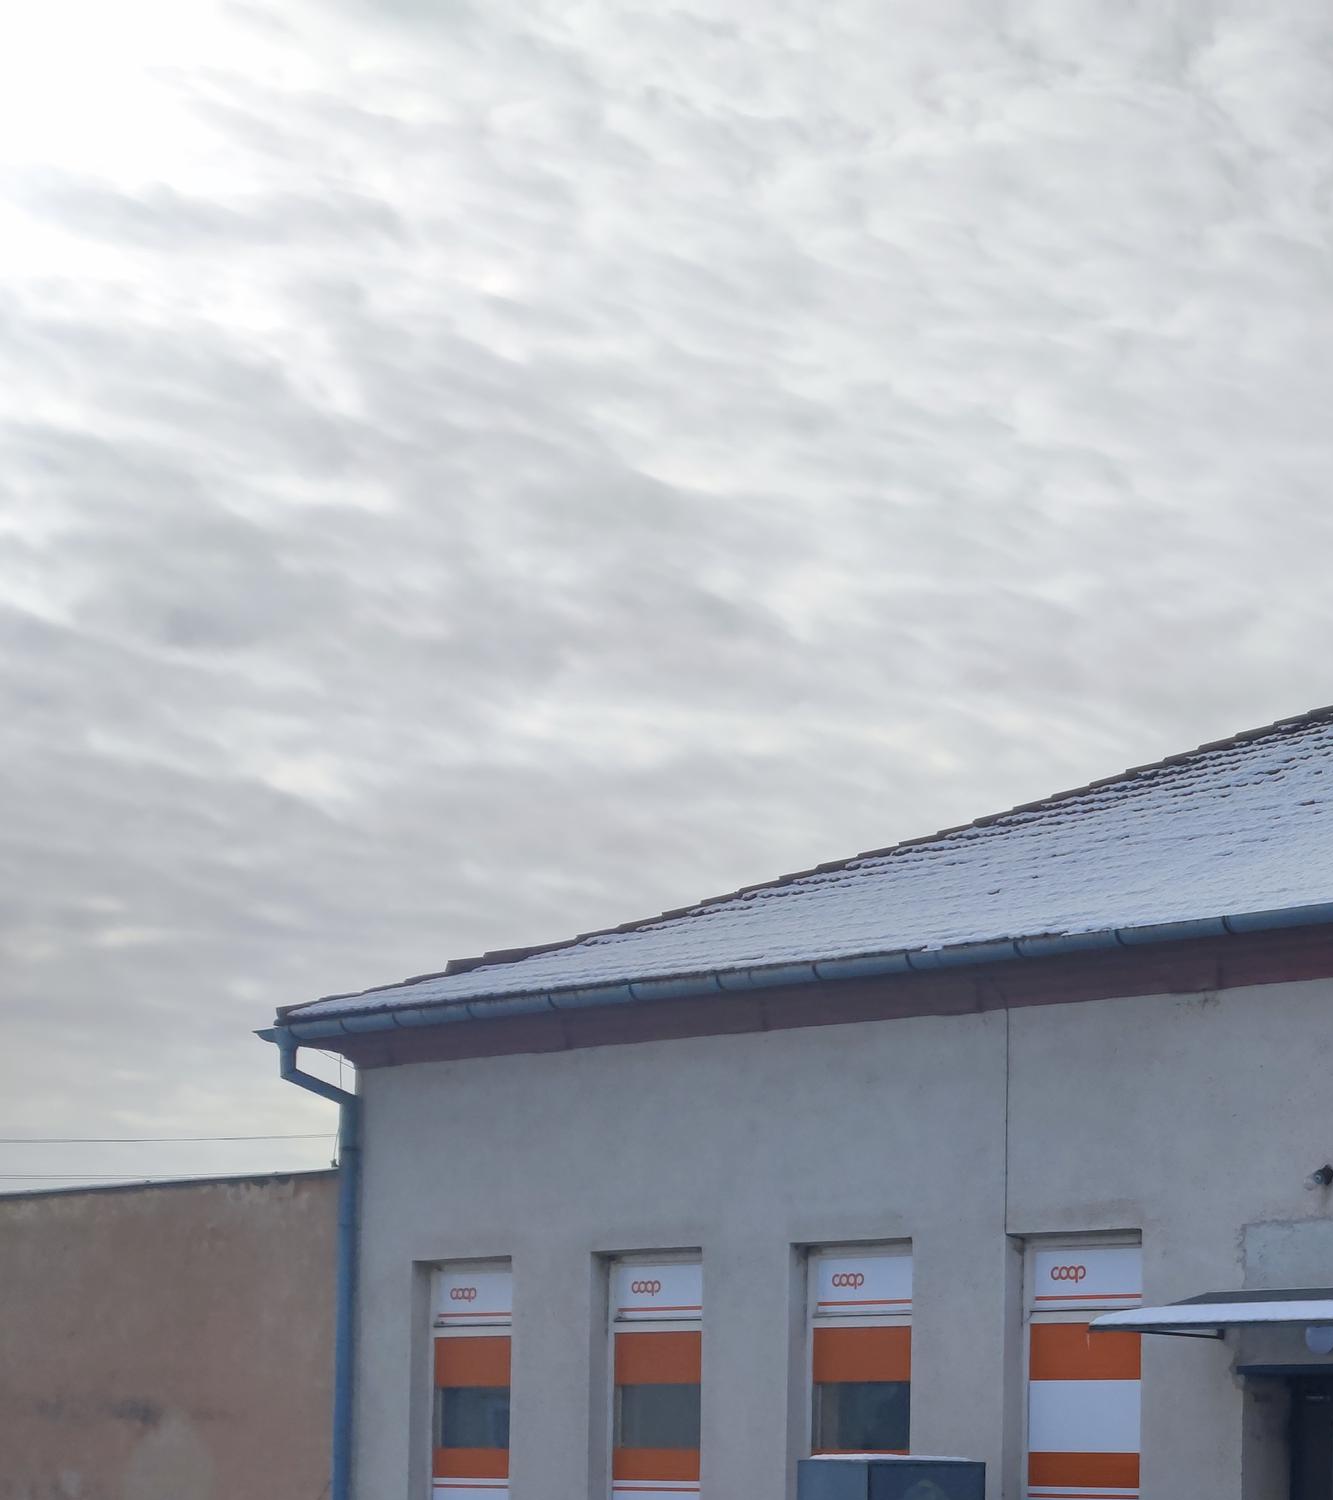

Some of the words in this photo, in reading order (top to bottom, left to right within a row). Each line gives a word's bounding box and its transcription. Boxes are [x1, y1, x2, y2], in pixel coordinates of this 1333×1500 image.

[831, 1272, 865, 1290] coop
[1050, 1264, 1087, 1284] coop
[450, 1287, 477, 1303] coop
[631, 1280, 661, 1297] coop
